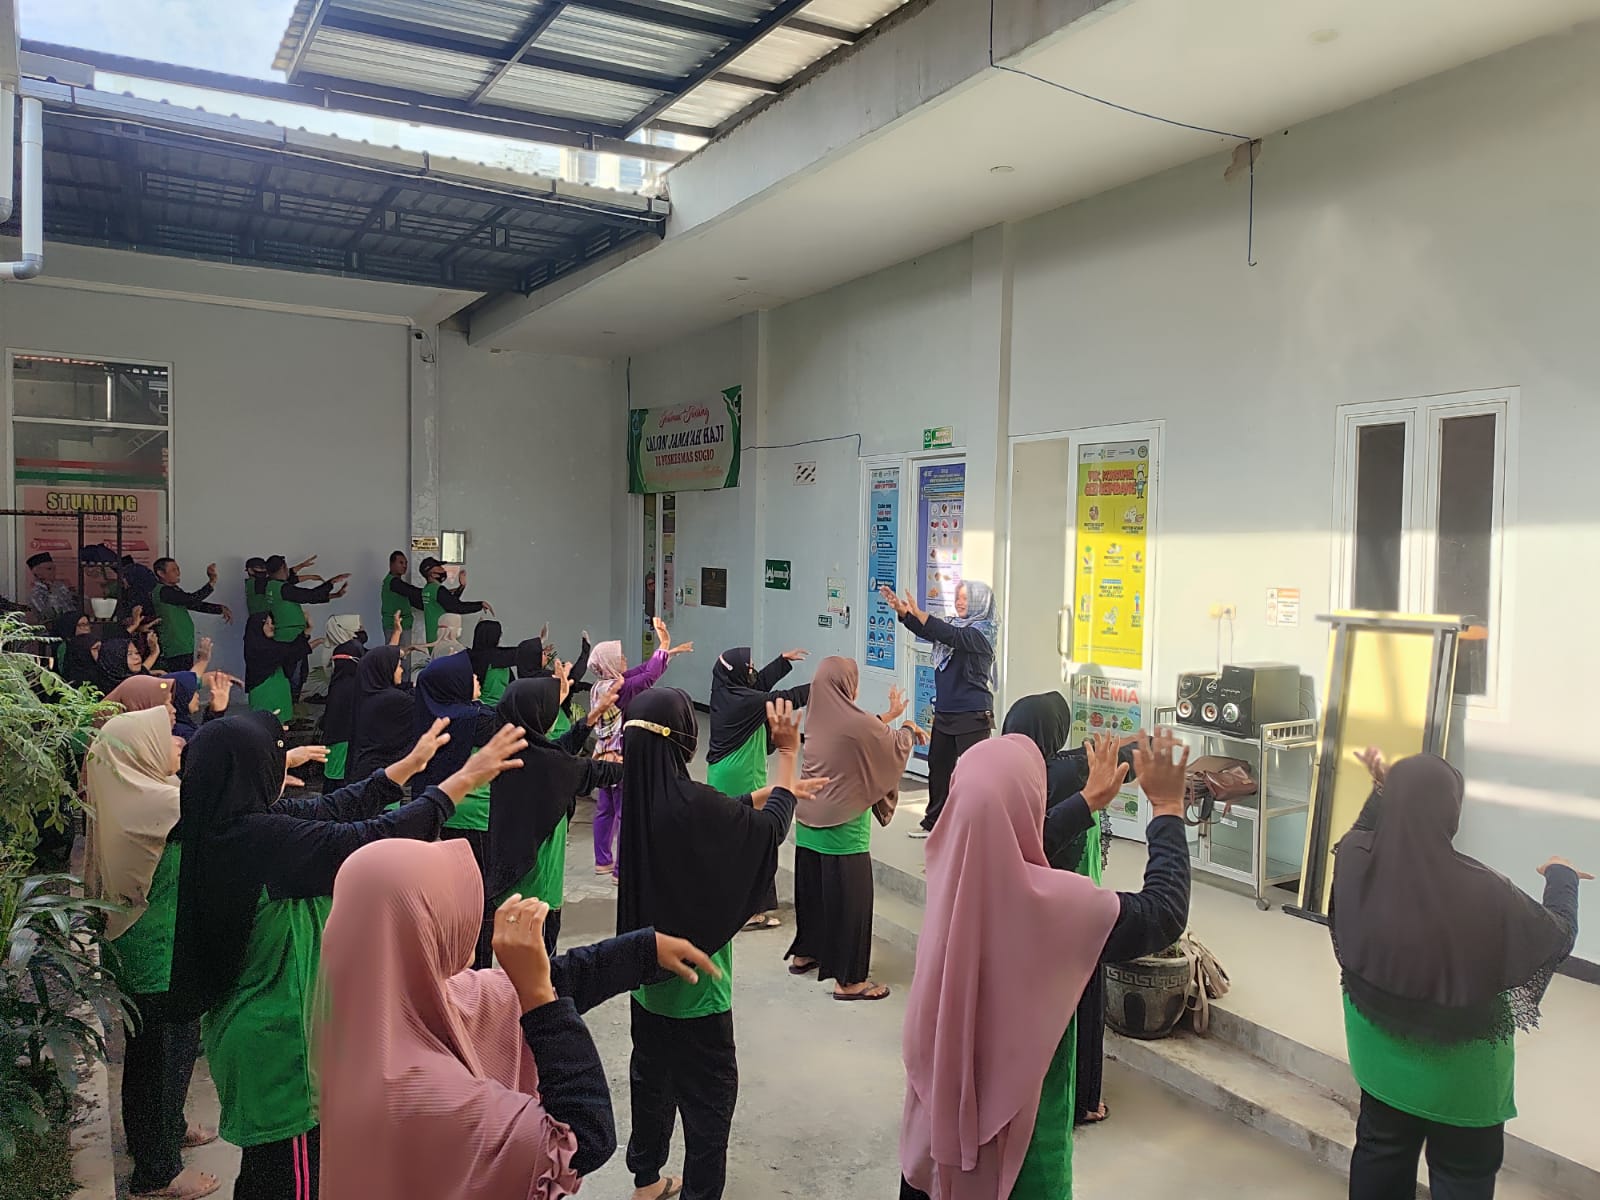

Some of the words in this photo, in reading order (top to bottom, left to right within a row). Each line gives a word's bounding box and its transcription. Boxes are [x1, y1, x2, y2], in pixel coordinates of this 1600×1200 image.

[646, 433, 669, 452] CALON
[703, 425, 725, 444] HAJI
[694, 449, 715, 462] SUGIO
[47, 492, 137, 512] STUNTING
[1078, 685, 1140, 705] ANEMIA
